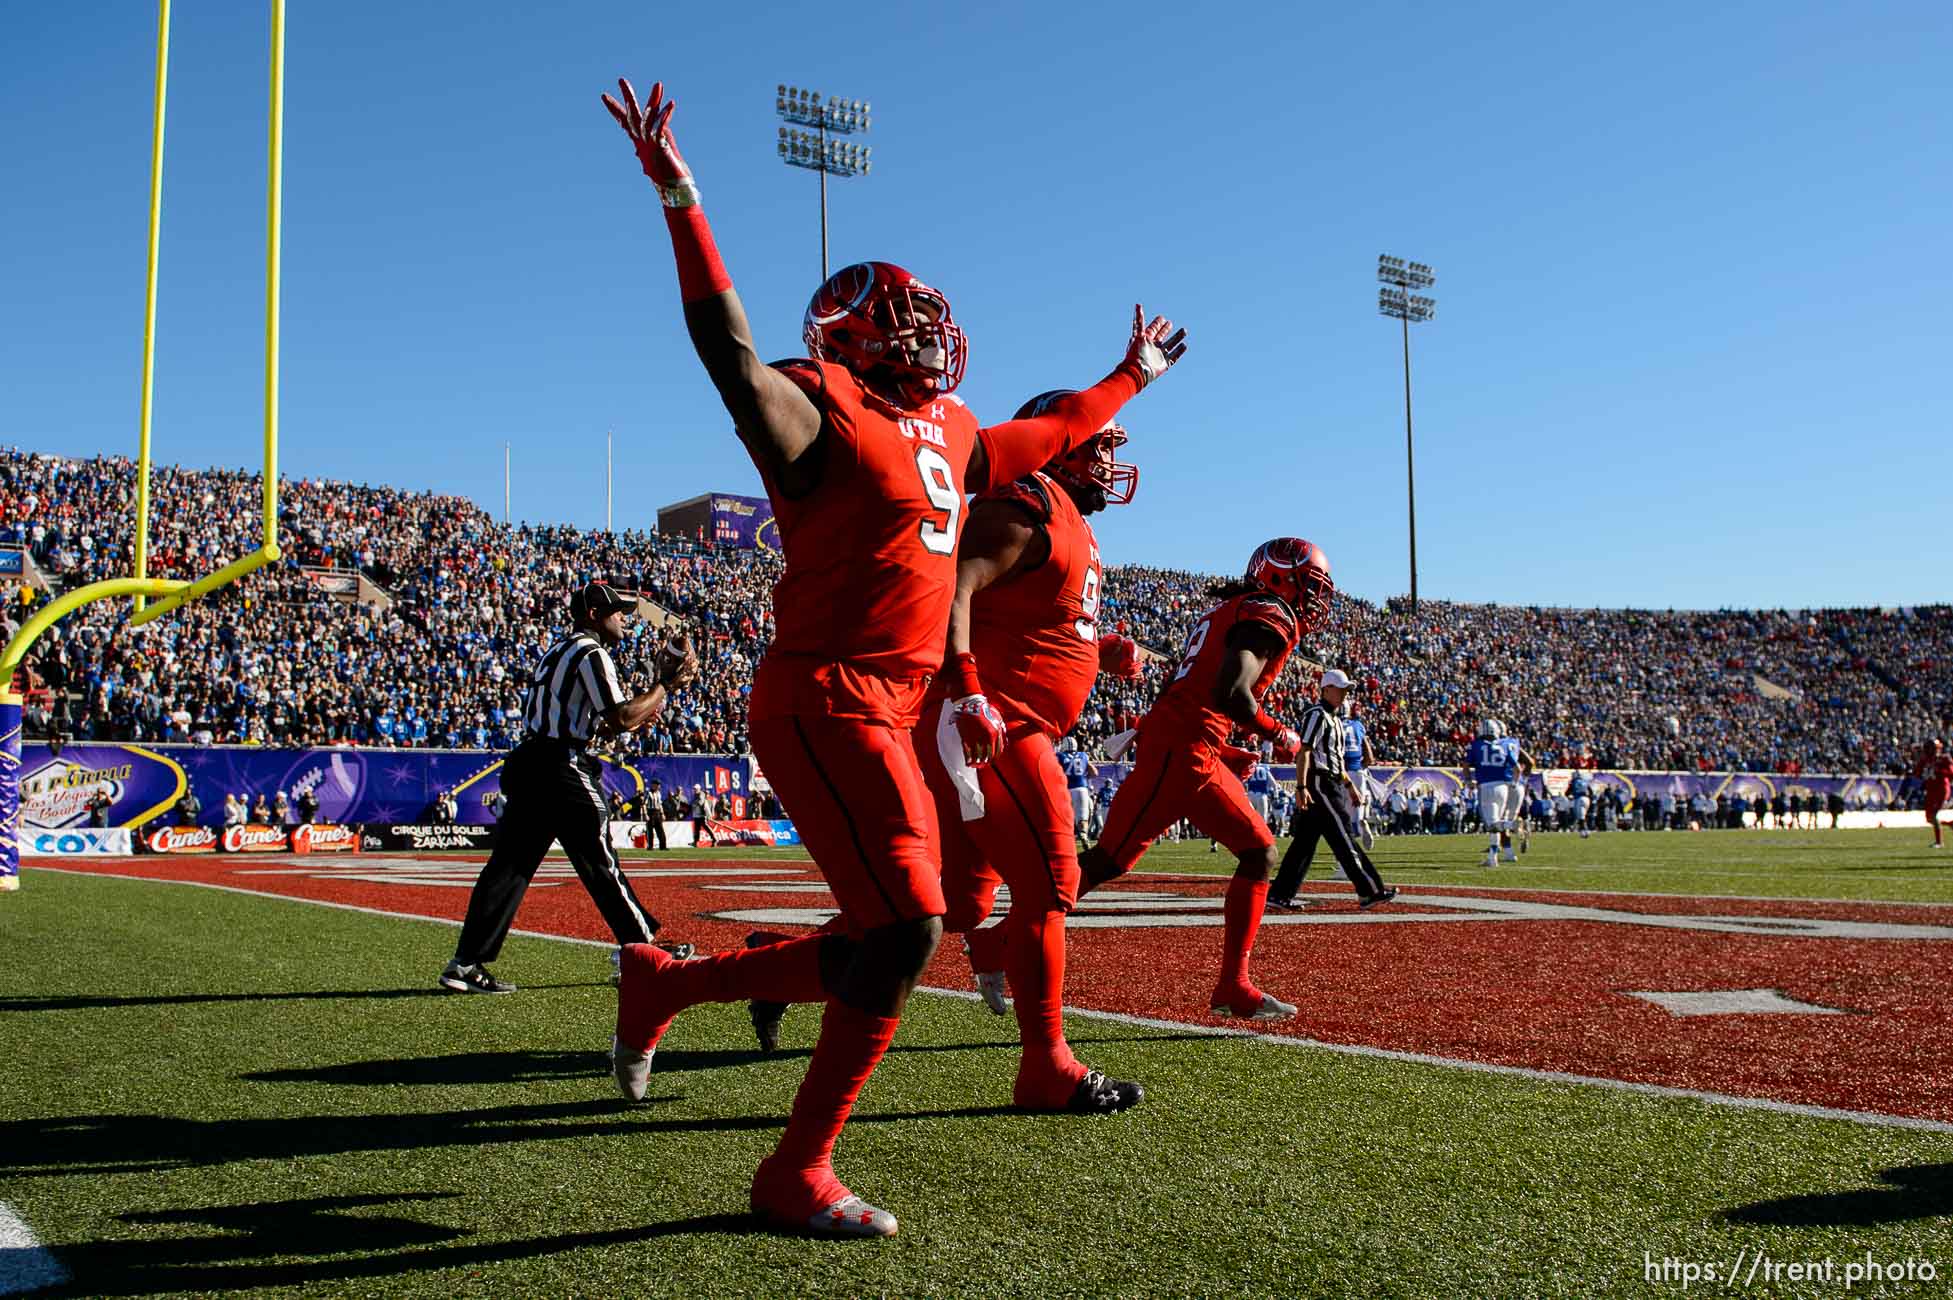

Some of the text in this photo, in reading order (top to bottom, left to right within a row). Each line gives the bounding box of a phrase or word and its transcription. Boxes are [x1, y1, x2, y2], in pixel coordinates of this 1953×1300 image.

[915, 445, 961, 556] 9
[704, 769, 741, 791] LAS
[151, 825, 217, 853] Cane's
[224, 824, 288, 852] Cane's
[391, 826, 491, 838] CIRQUE DU SOLEIL
[412, 835, 475, 849] ZARKANA
[34, 833, 110, 854] COX
